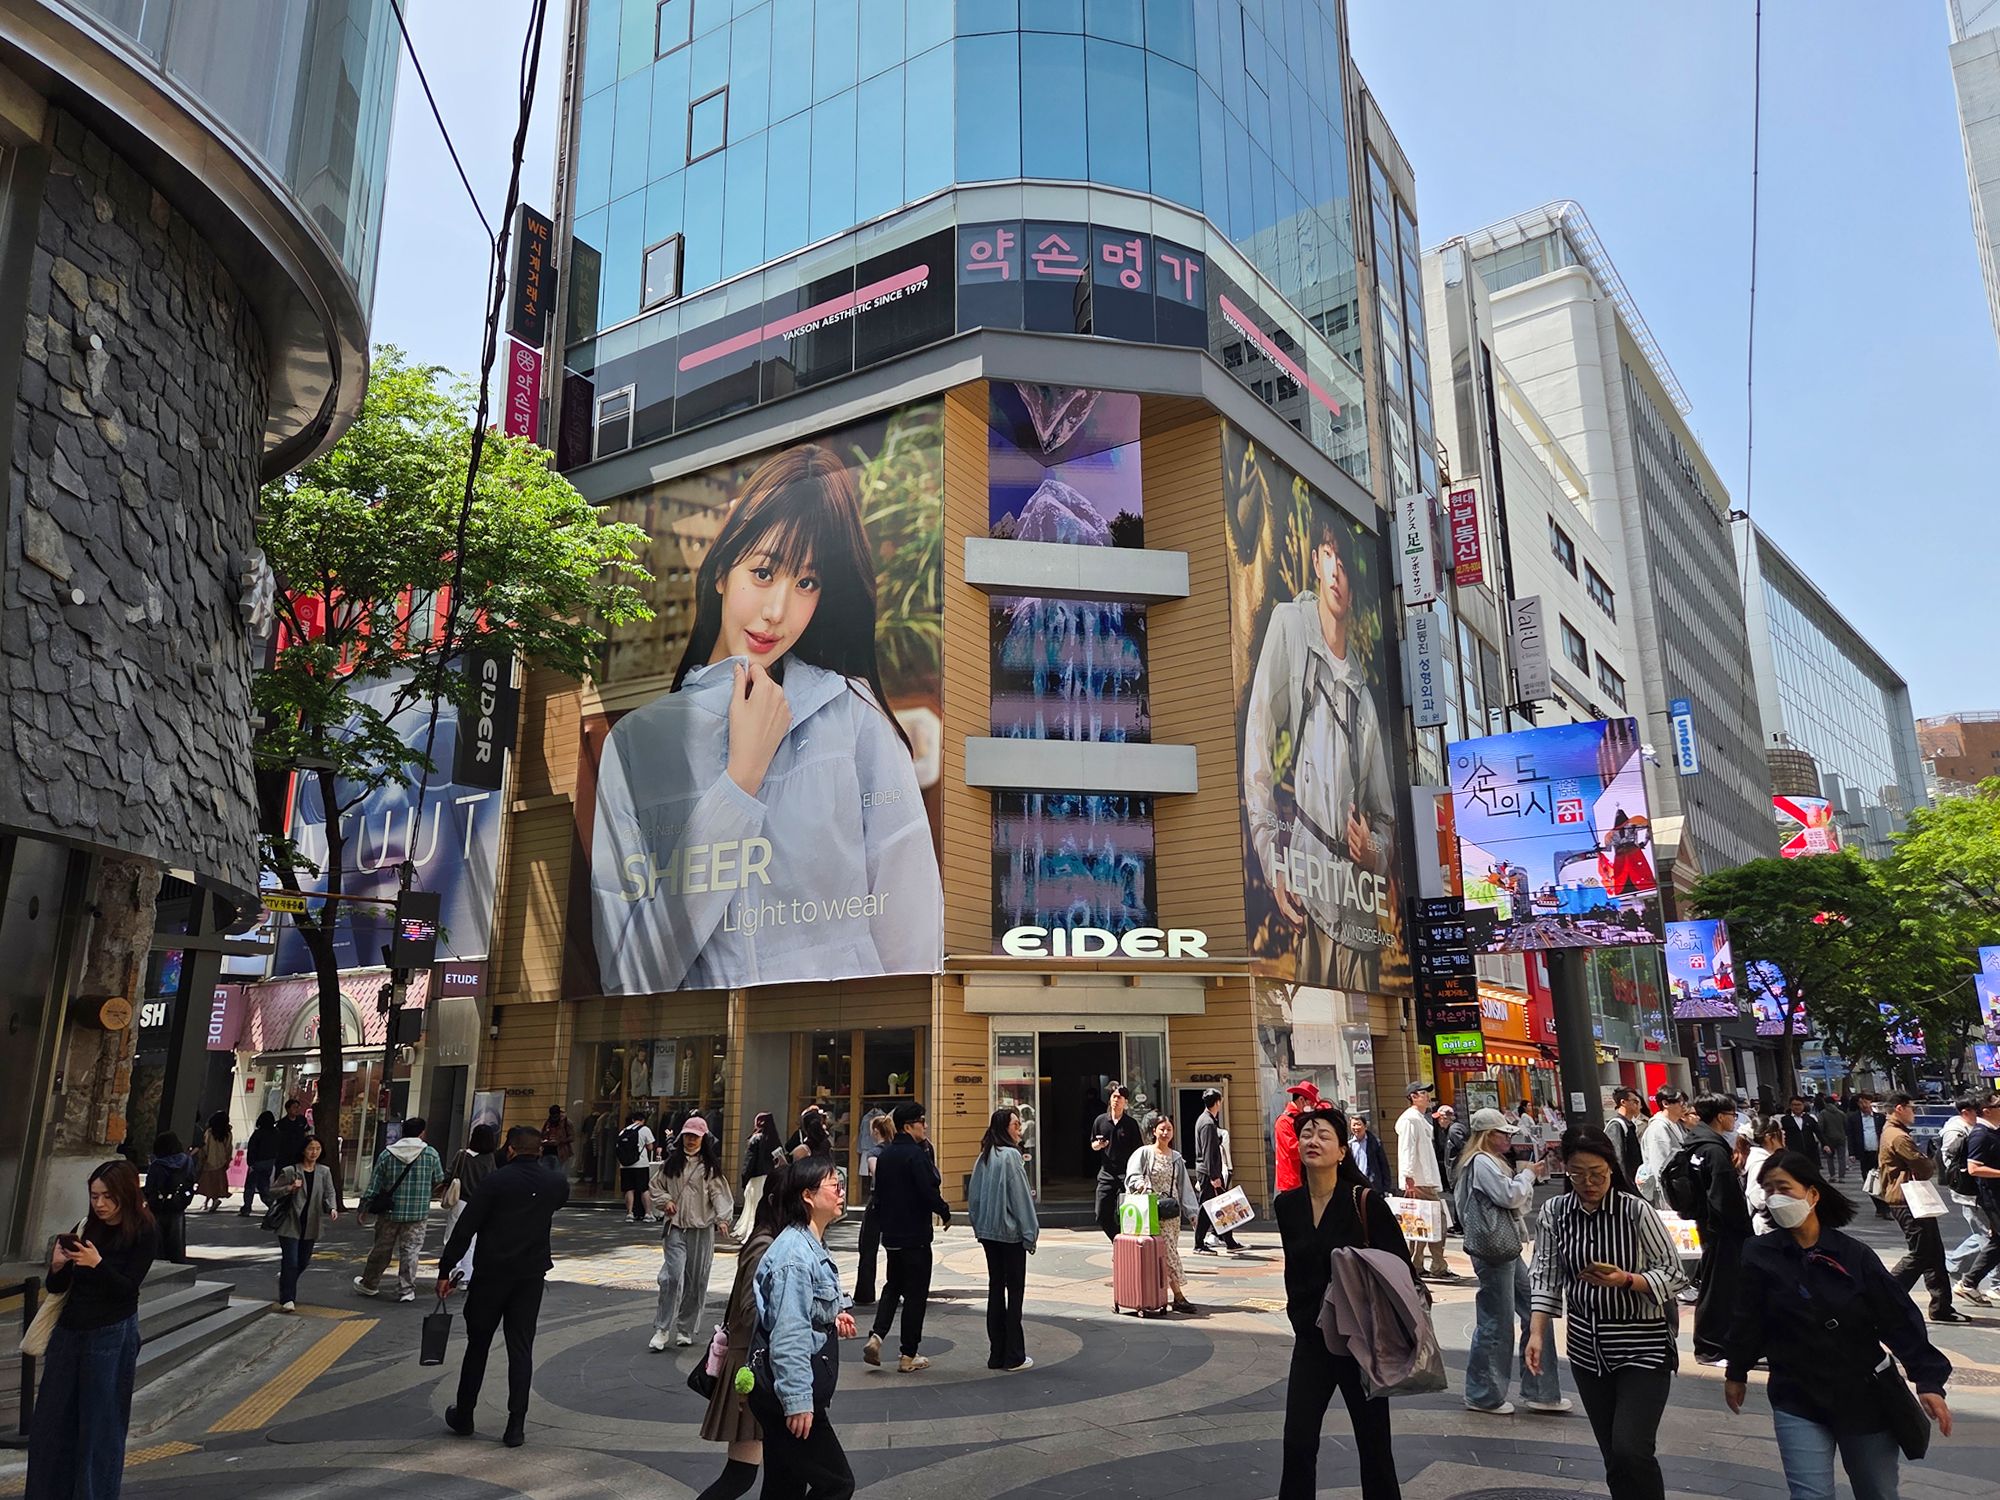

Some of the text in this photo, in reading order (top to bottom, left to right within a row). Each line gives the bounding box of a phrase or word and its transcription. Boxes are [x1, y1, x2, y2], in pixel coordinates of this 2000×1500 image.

[527, 217, 548, 240] WE
[524, 240, 541, 316] 시계거래소
[966, 228, 1200, 300] 약손명가
[782, 279, 928, 341] YAKSON AESTHETIC SINCE 1979
[514, 374, 533, 439] 약손명
[1451, 491, 1474, 506] 현대
[1453, 506, 1479, 561] 부동산
[1416, 619, 1434, 711] 김동진 성형외과
[476, 658, 498, 764] EIDER
[1677, 719, 1693, 767] unesco
[862, 788, 902, 809] EIDER
[655, 821, 695, 836] Nature
[618, 836, 774, 903] SHEER
[1270, 842, 1389, 918] HERITAGE
[723, 891, 891, 937] Light to wear
[1341, 922, 1396, 948] WINDBREAKER
[1001, 925, 1210, 958] EIDER
[1432, 955, 1470, 966] 보드게임
[445, 973, 479, 985] ETUDE
[1445, 980, 1460, 988] WE
[207, 989, 228, 1045] ETUDE
[655, 1044, 675, 1054] TOUR
[1442, 1039, 1477, 1049] nail art
